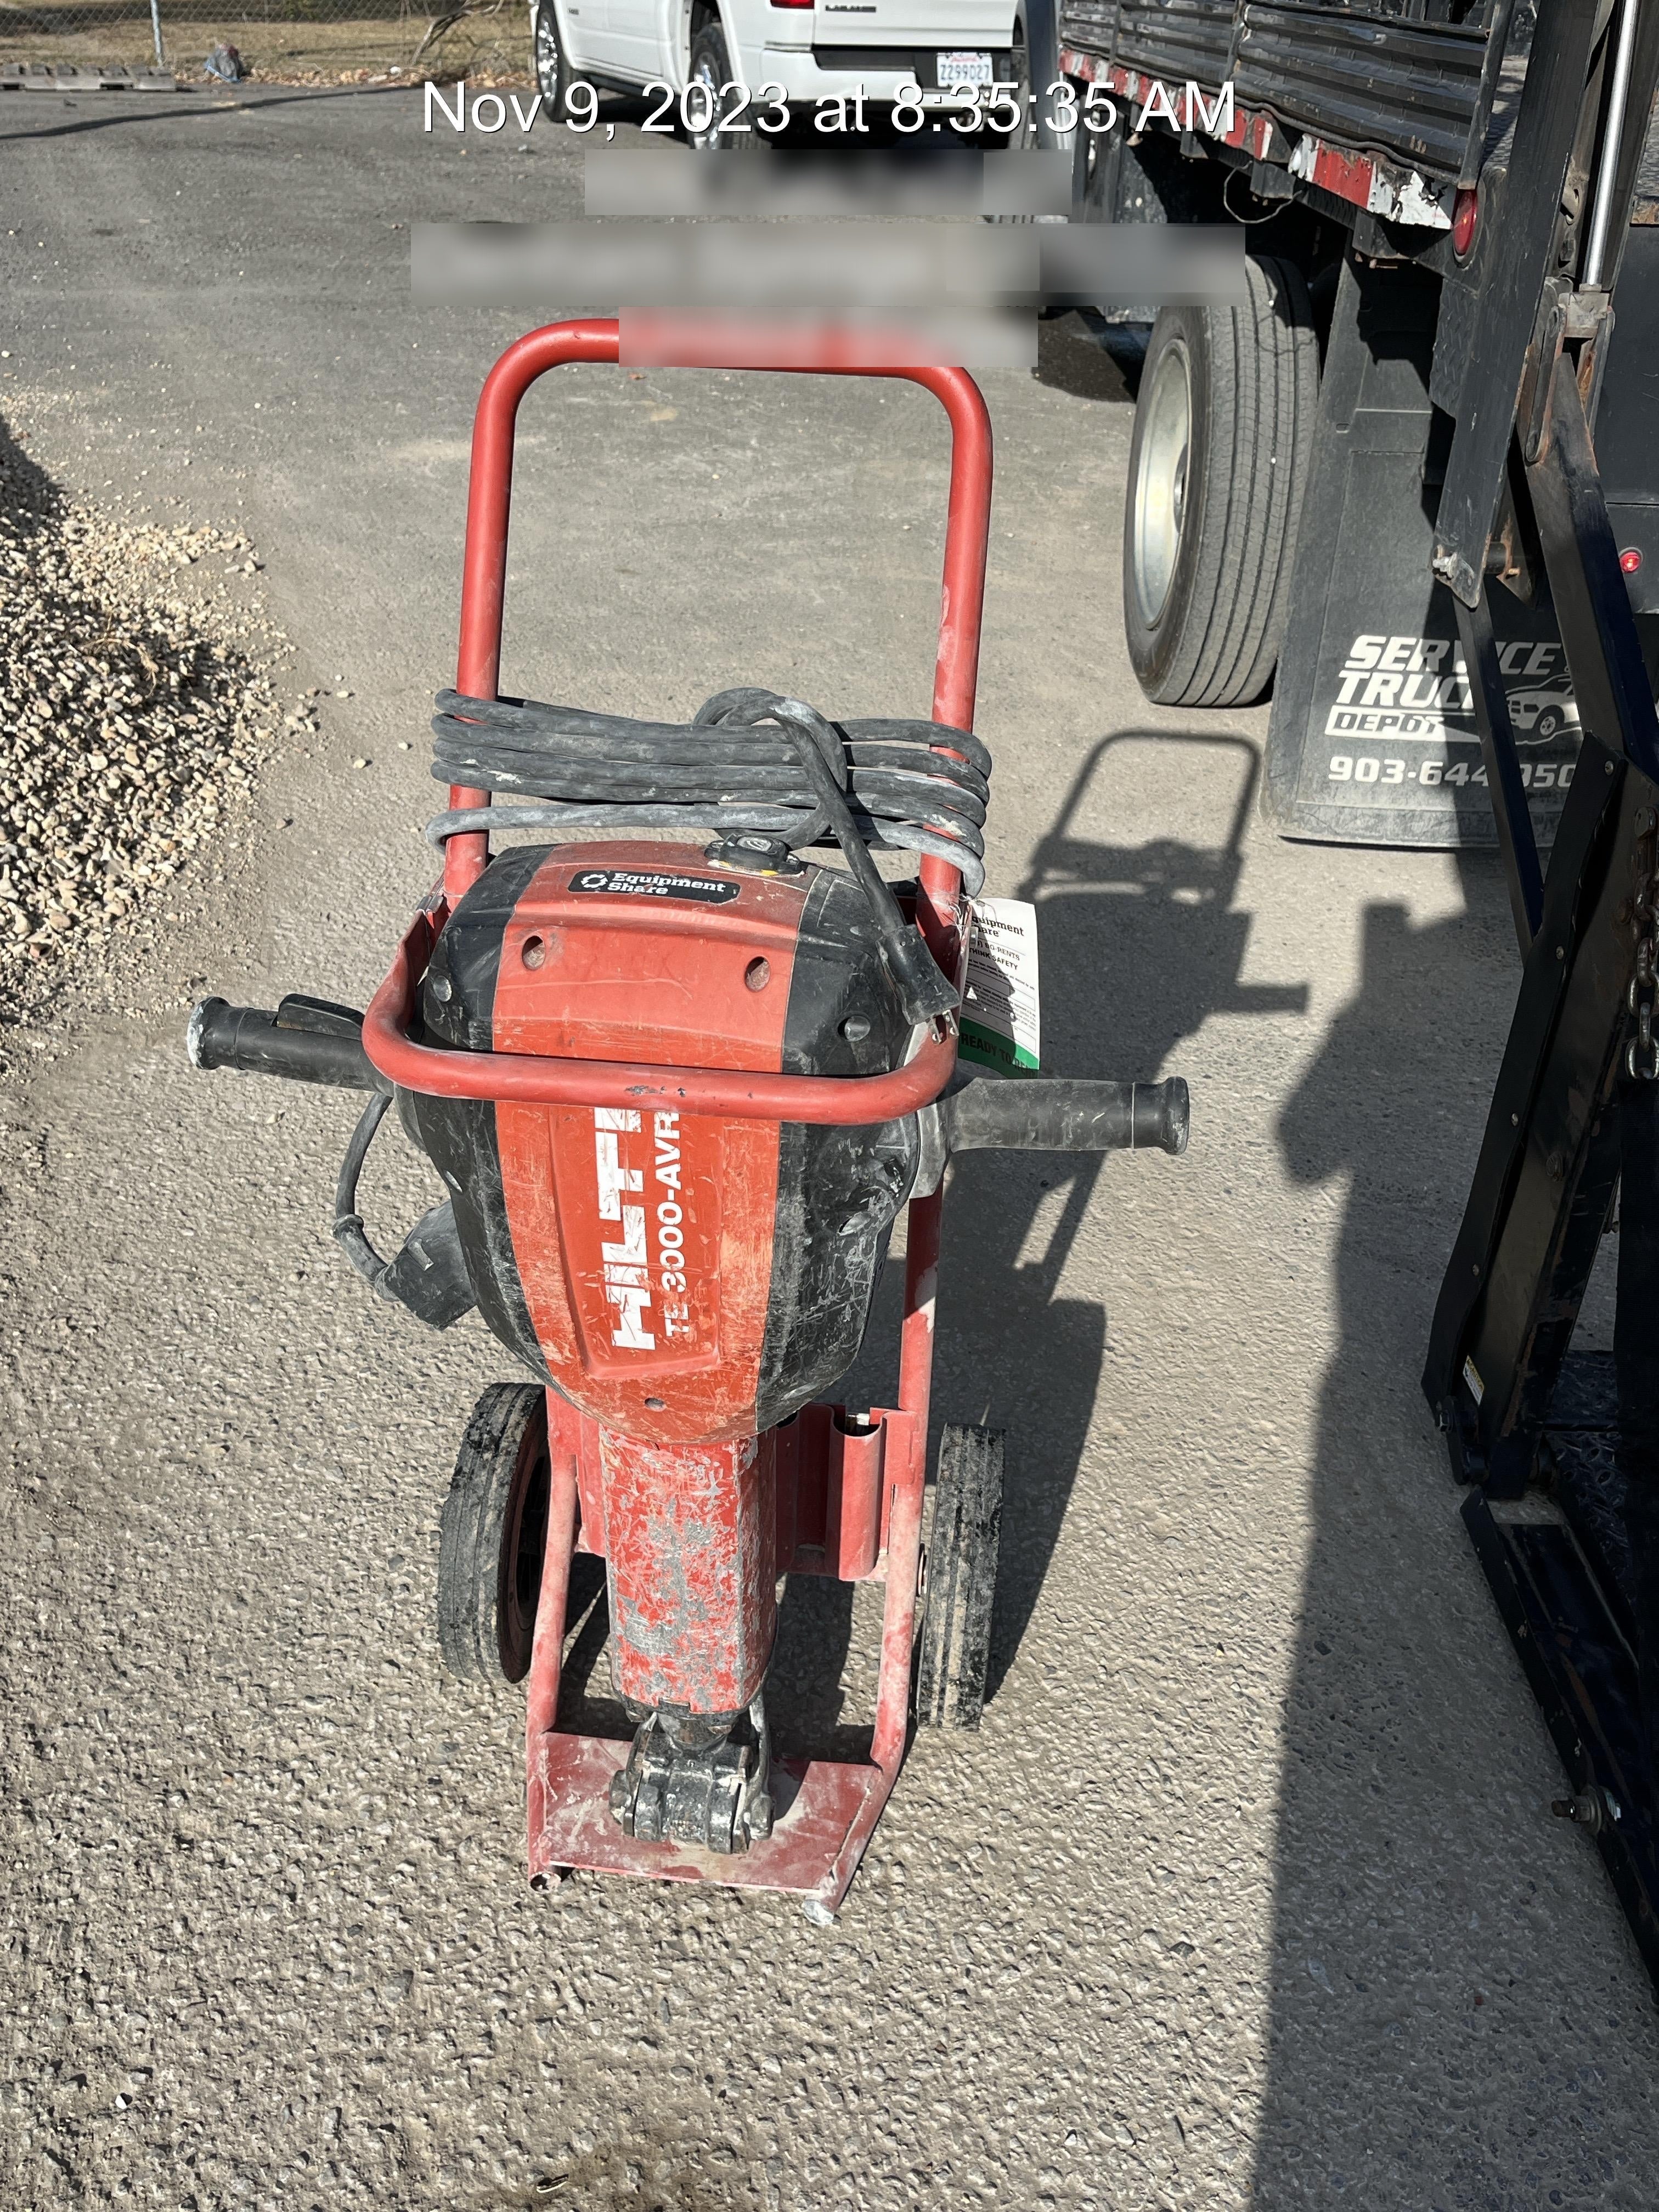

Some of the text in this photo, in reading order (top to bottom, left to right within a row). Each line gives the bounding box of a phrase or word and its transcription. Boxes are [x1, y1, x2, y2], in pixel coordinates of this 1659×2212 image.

[1333, 712, 1443, 735] DEPOT
[607, 882, 669, 895] Share
[612, 872, 726, 893] Equipment
[972, 915, 1025, 936] quipment
[991, 955, 1019, 970] SAFETY
[960, 1032, 997, 1057] READY
[999, 1048, 1014, 1065] TO
[653, 1111, 687, 1294] 3000-AVR
[593, 1106, 656, 1351] HILTI
